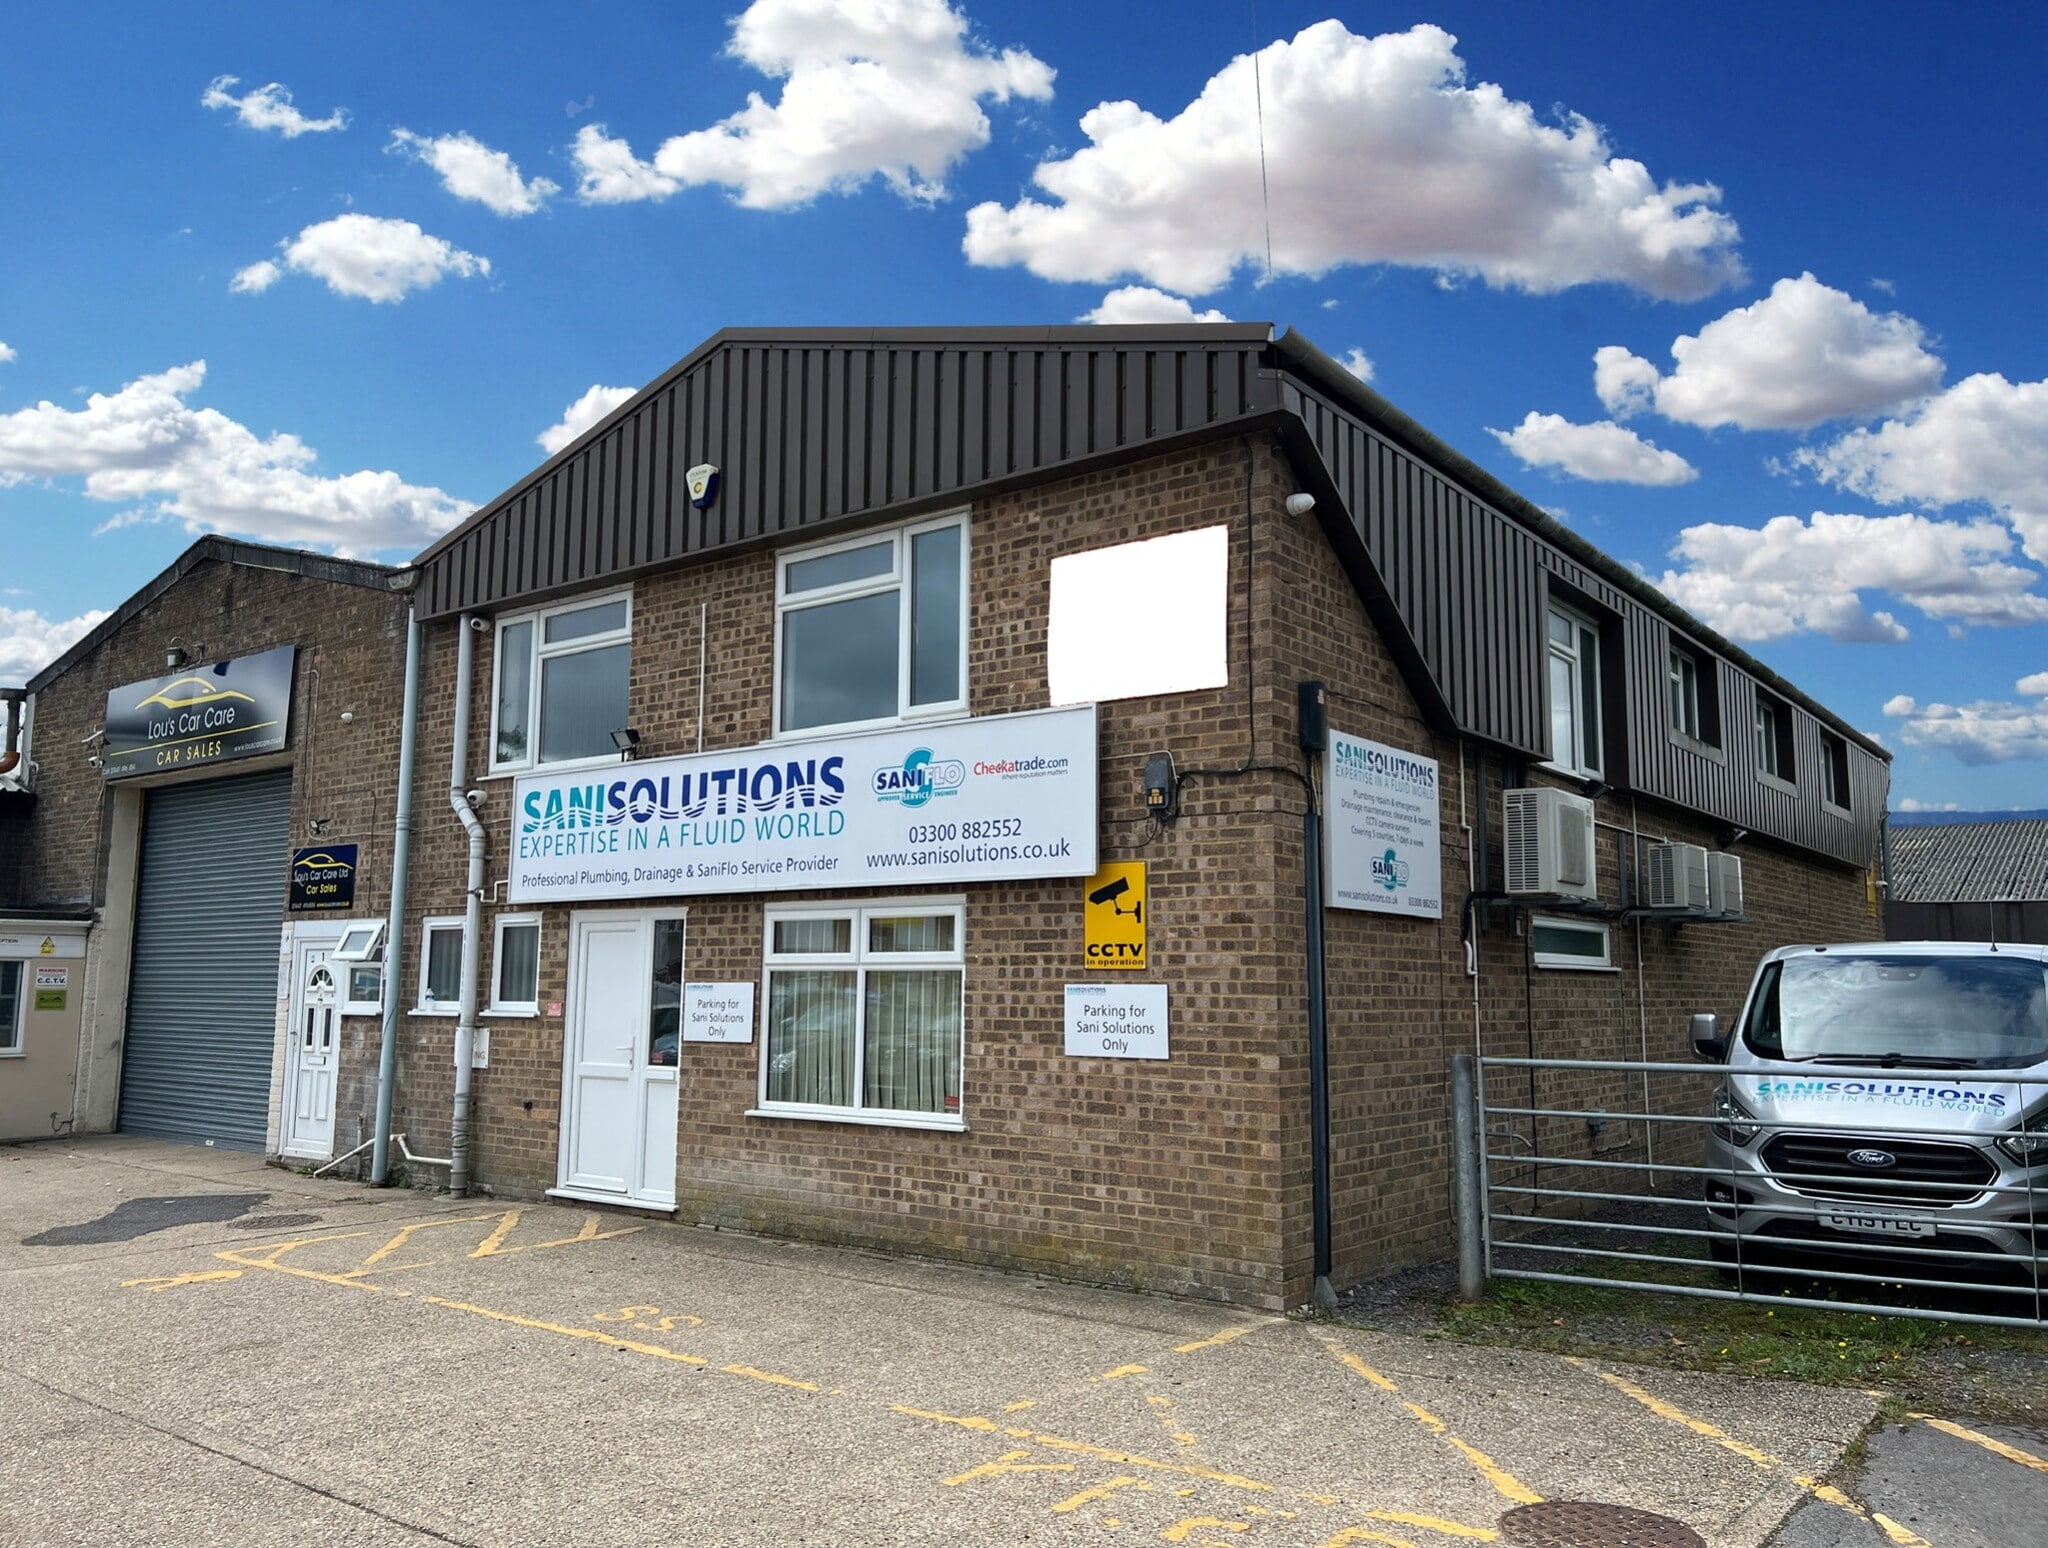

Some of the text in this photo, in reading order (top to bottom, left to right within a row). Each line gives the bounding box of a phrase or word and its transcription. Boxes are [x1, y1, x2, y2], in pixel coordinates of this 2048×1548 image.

[148, 707, 235, 740] Lou's Car Care
[156, 740, 221, 766] CAR SALES
[973, 756, 1069, 776] Checkatrade.com
[1336, 741, 1434, 788] SANISOLUTIONS
[1336, 765, 1373, 785] EXPERTISE
[523, 756, 845, 833] SANISOLUTIONS
[520, 810, 845, 859] EXPERTISE IN A FLUID WORLD
[909, 818, 1022, 843] 03300 882552
[867, 837, 1071, 868] www.sanisolutions.co.uk
[310, 870, 321, 881] Car
[322, 869, 337, 880] Care
[339, 868, 349, 878] Ltd
[522, 854, 839, 888] Professional Plumbing, Drainage & SaniFlo Service Provider
[306, 883, 337, 895] Car Sales
[1087, 944, 1143, 957] CCTV
[1098, 959, 1144, 967] operation
[697, 998, 740, 1012] Parking for
[1084, 1005, 1146, 1020] Parking for
[692, 1013, 744, 1023] Sani Solutions
[1077, 1021, 1155, 1035] Sani Solutions
[708, 1026, 726, 1039] Only
[1102, 1038, 1128, 1054] Only
[1752, 1093, 2006, 1117] EXPERTISE IN A FLUID WORLD
[1756, 1082, 2006, 1108] SANISOLUTIONS
[1857, 1152, 1885, 1163] Ford
